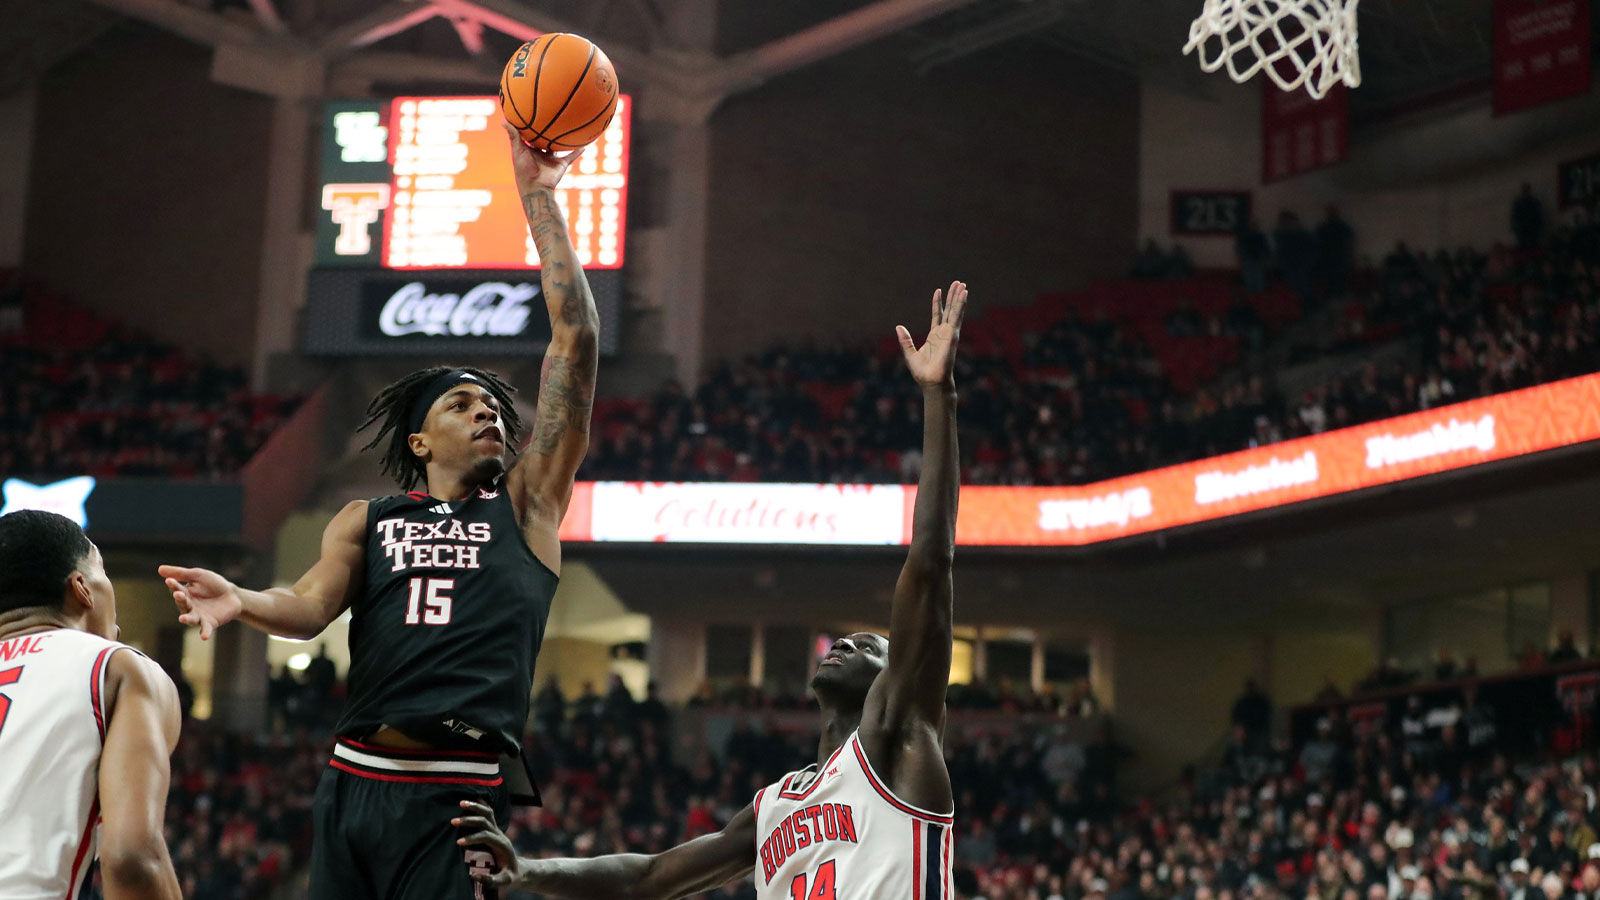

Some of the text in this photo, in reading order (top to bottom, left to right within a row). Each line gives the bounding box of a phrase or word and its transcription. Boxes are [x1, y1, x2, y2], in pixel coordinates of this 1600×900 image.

[376, 518, 492, 547] TEXAS
[385, 541, 481, 573] TECH
[404, 576, 456, 626] 15
[759, 802, 859, 886] HOUSTON
[790, 858, 838, 900] 14
